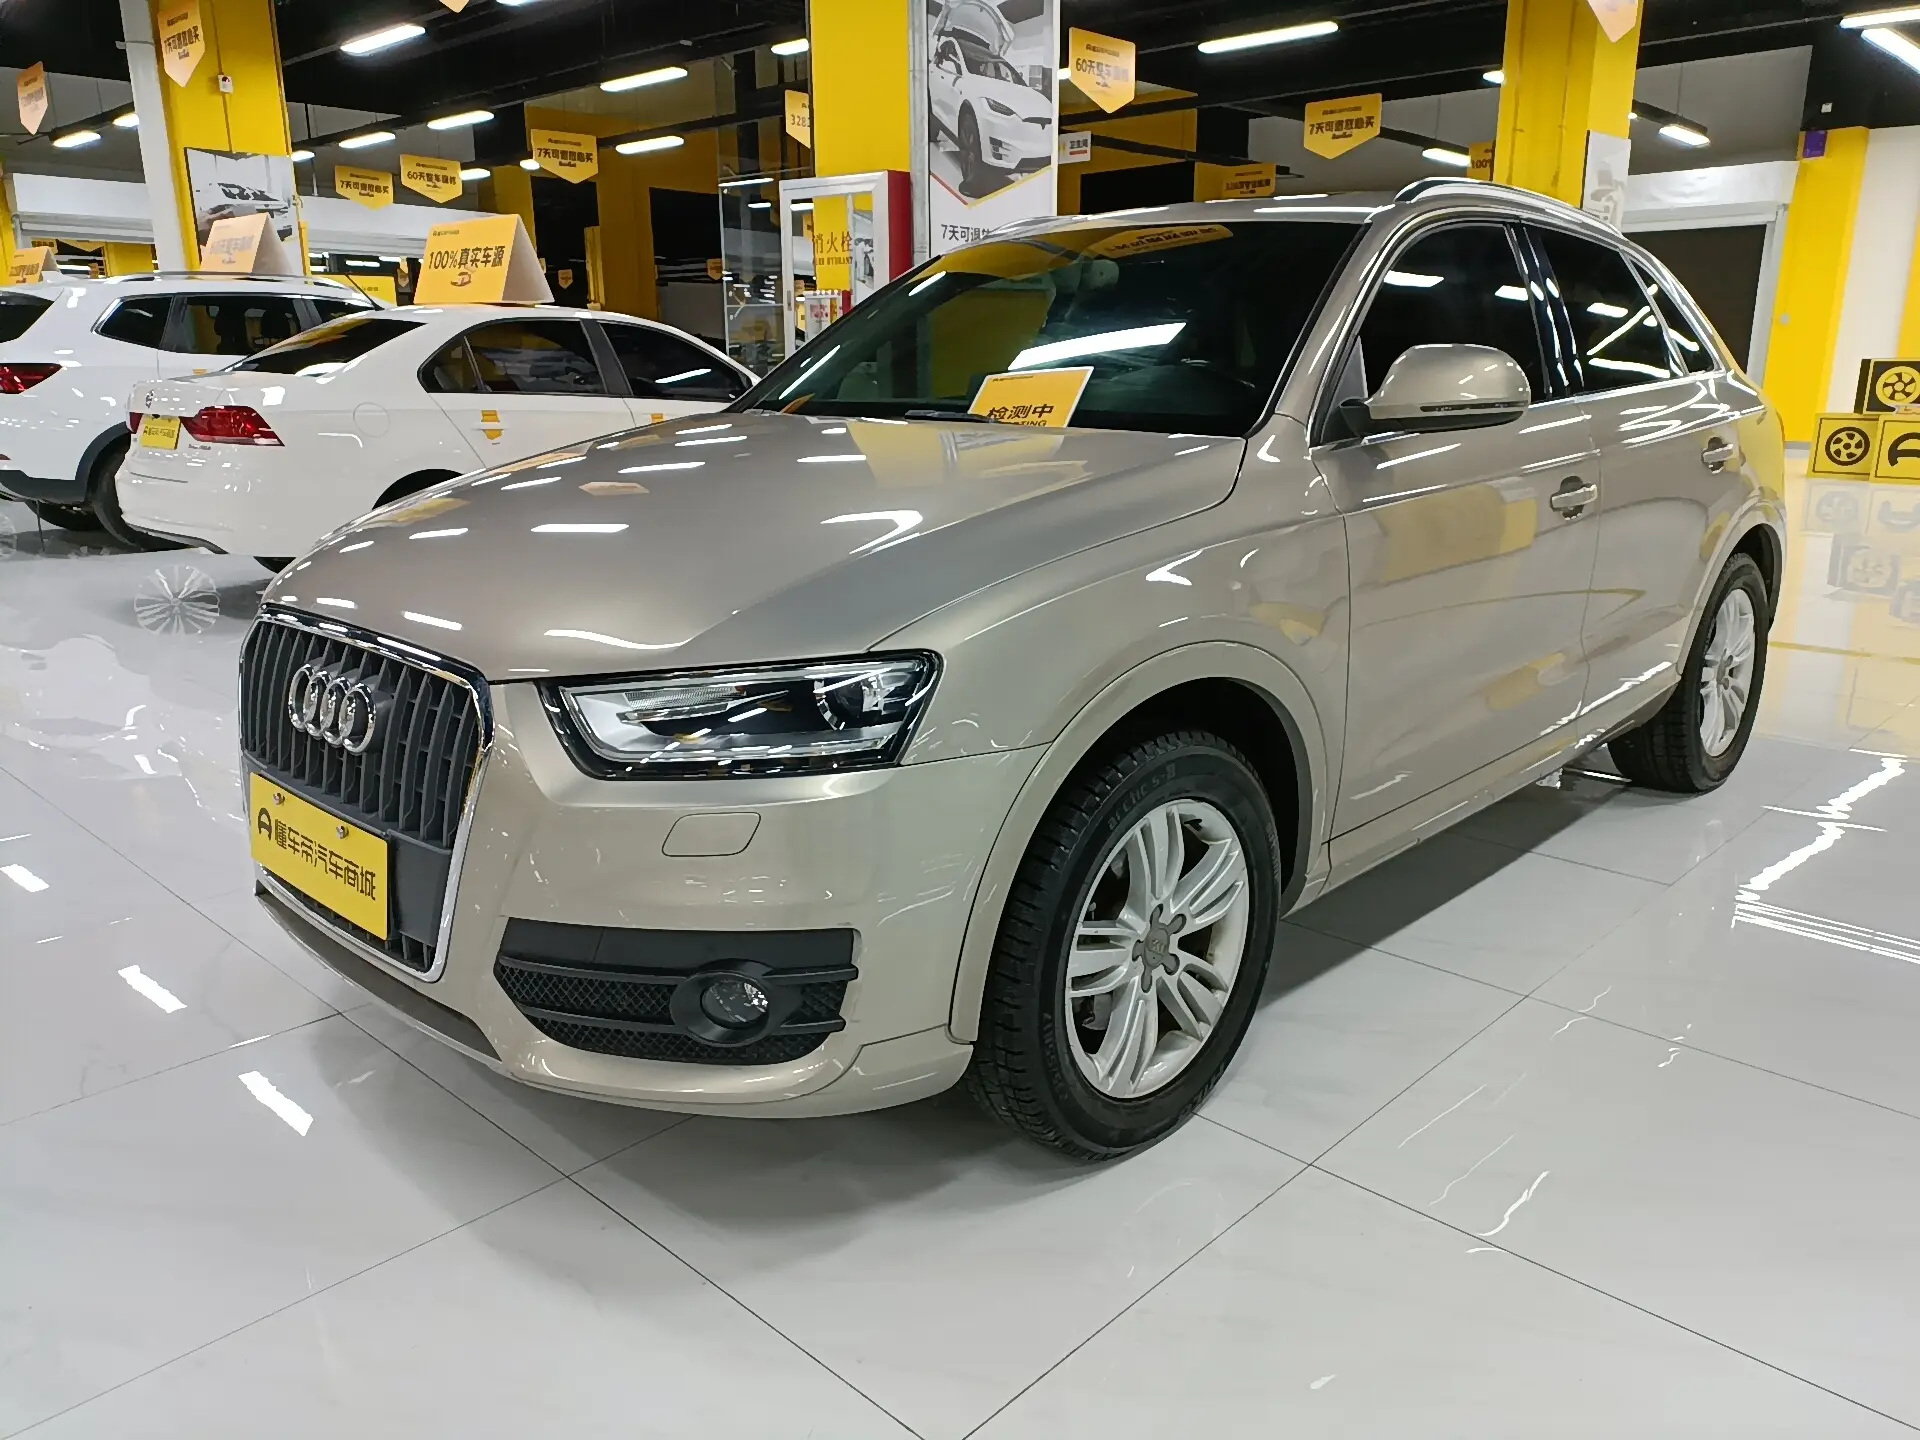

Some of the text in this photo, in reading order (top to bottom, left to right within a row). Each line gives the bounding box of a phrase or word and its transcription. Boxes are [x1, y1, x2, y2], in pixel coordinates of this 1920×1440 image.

[428, 245, 506, 270] 100%真实车源
[987, 403, 1054, 420] 检测中
[274, 818, 376, 901] 懂车帝汽车商城
